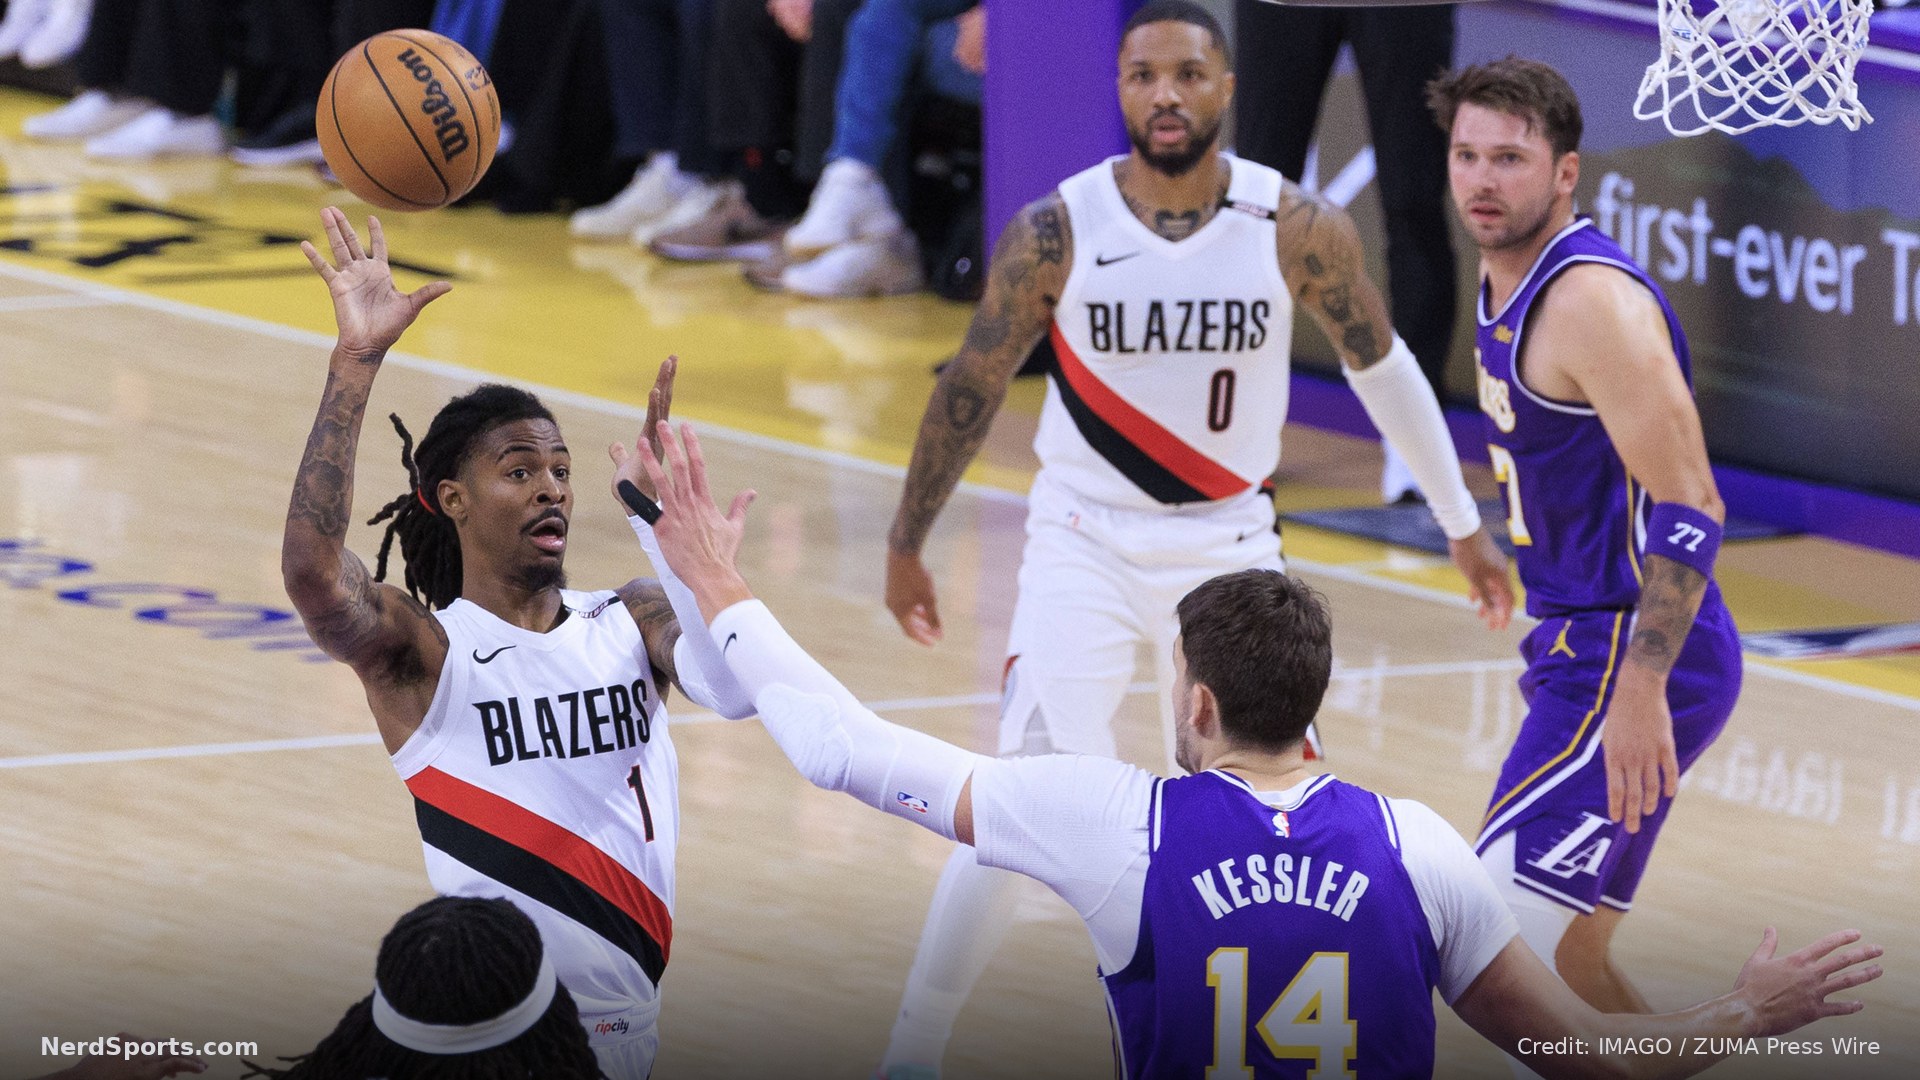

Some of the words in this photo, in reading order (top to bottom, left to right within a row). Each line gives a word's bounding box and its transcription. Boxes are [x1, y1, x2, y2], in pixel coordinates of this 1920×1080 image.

[398, 48, 469, 165] Wilson
[1594, 171, 1867, 316] first-ever
[1879, 228, 1920, 326] T
[1086, 299, 1270, 353] BLAZERS
[1207, 367, 1236, 432] 0
[1667, 521, 1707, 552] 77
[472, 678, 651, 767] BLAZERS
[626, 764, 655, 843] 1
[1525, 810, 1614, 880] LA
[1191, 853, 1370, 922] KESSLER
[1204, 946, 1358, 1080] 14
